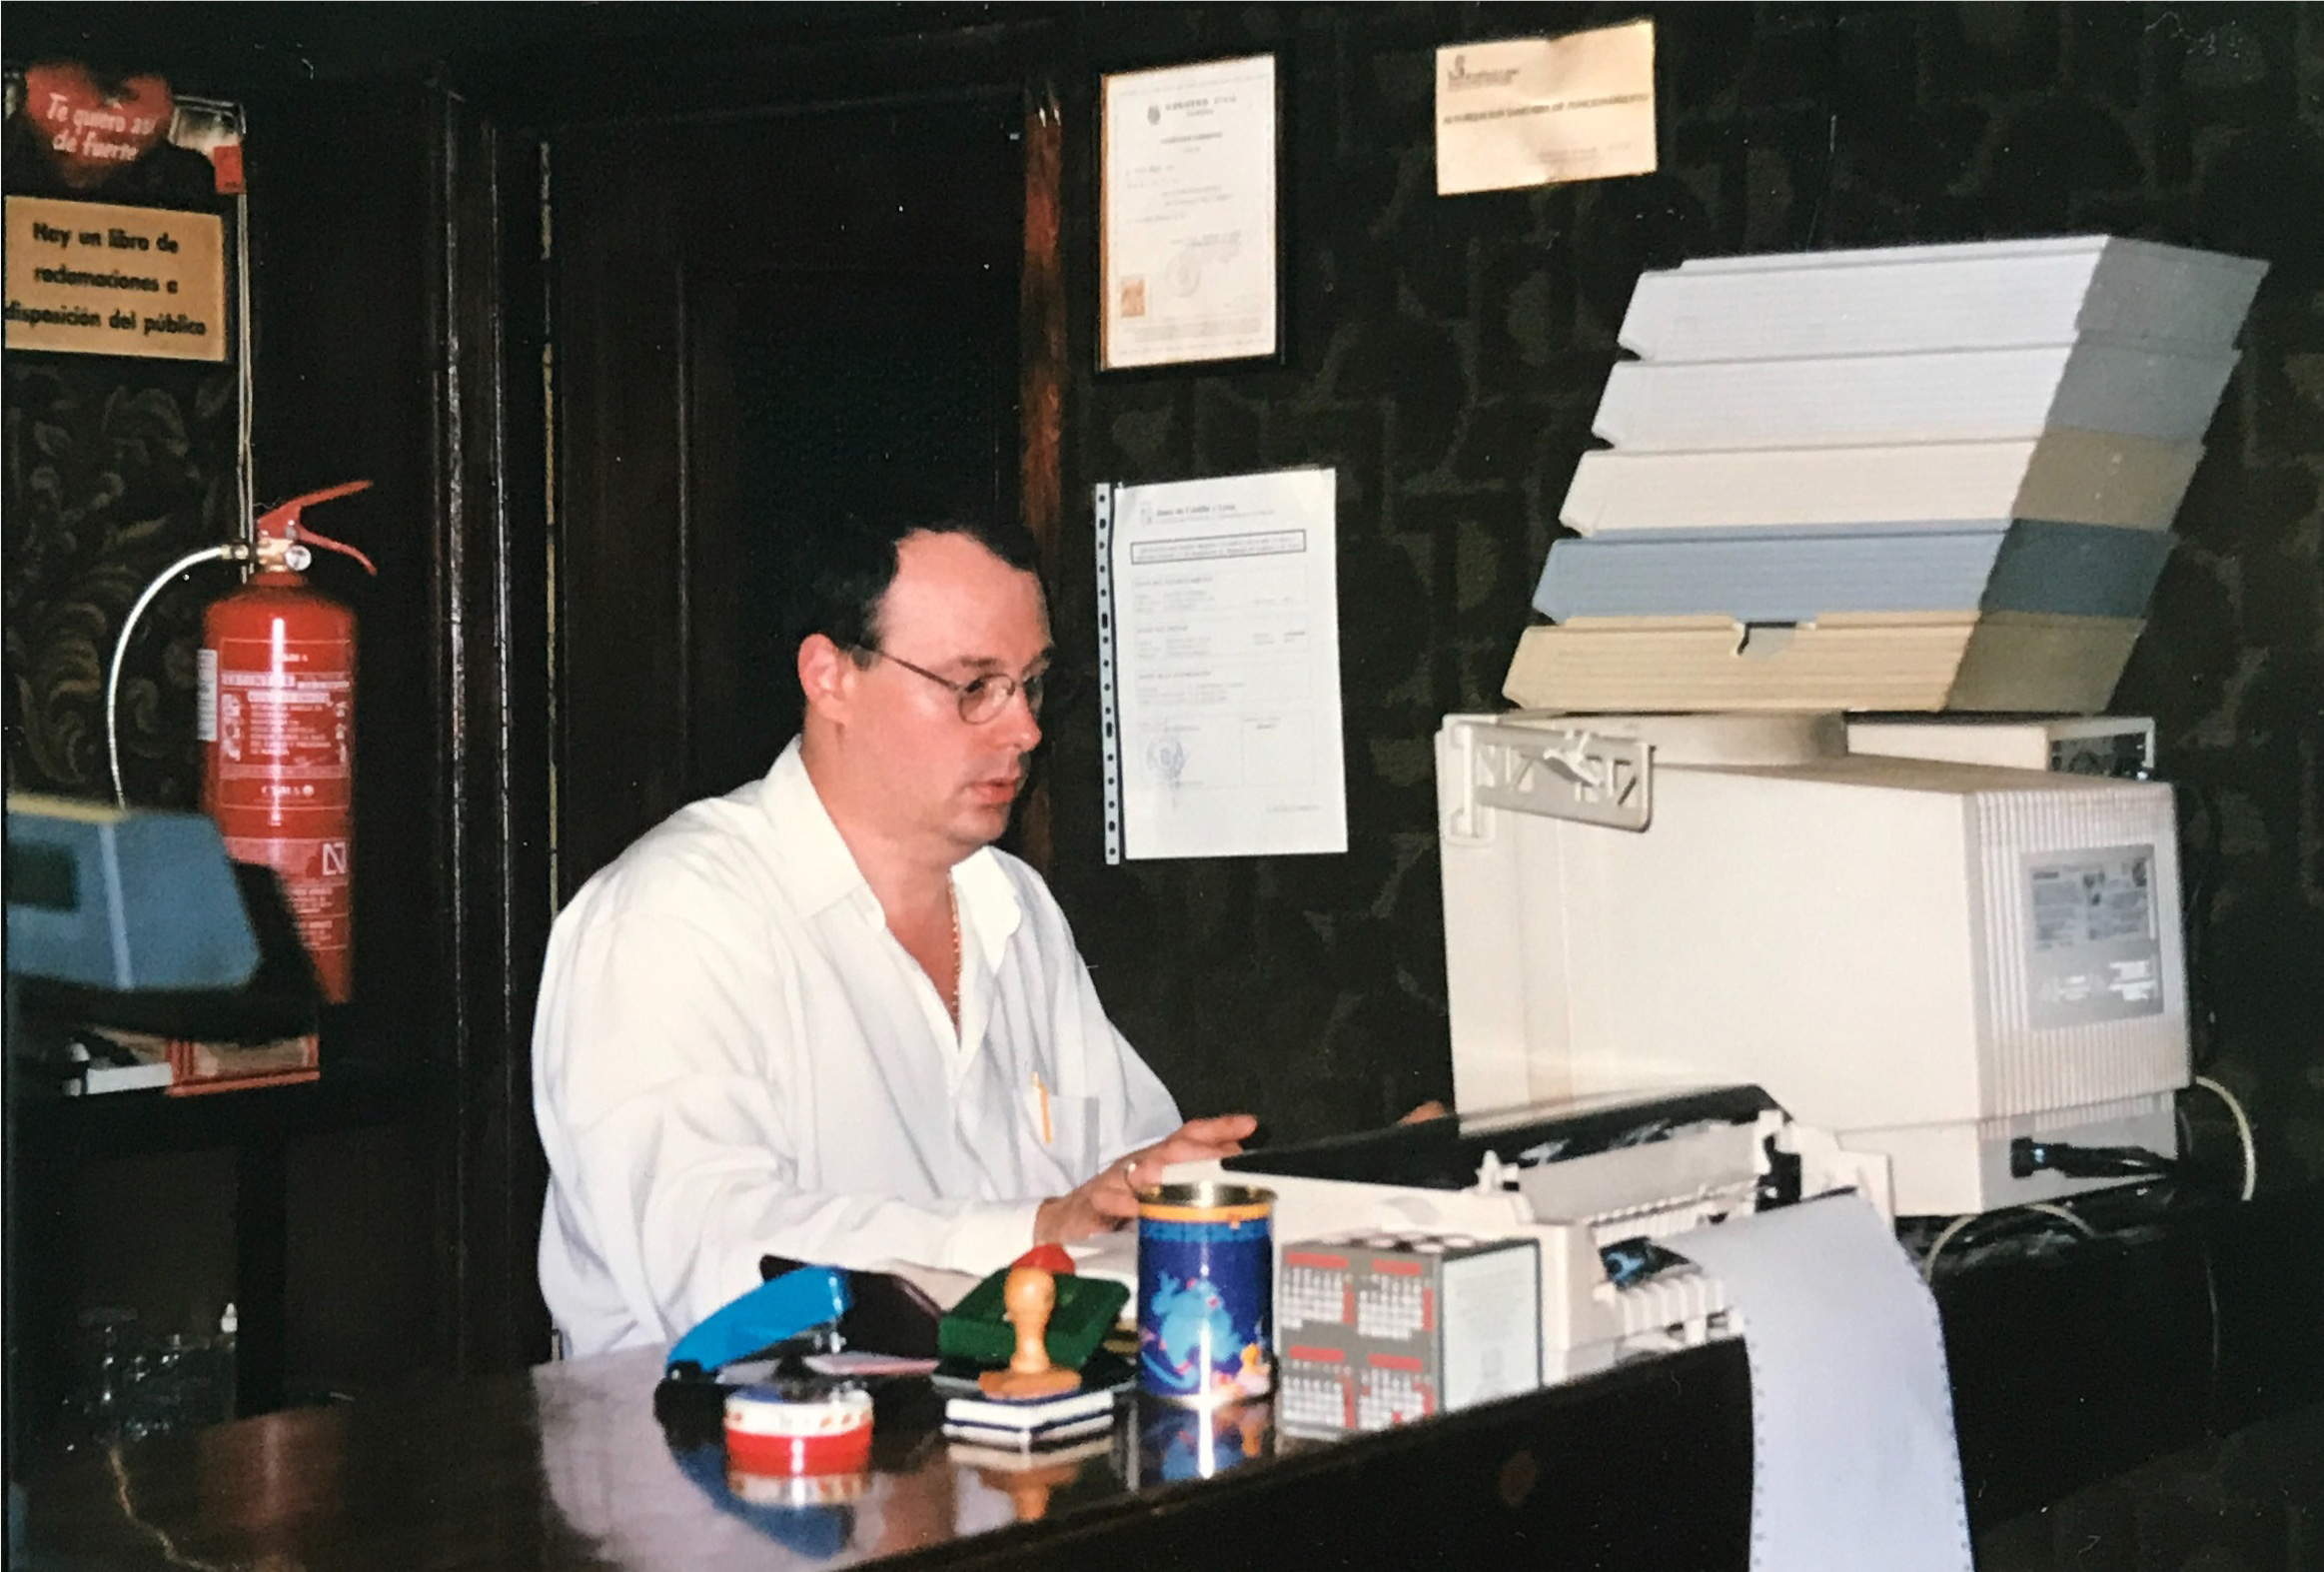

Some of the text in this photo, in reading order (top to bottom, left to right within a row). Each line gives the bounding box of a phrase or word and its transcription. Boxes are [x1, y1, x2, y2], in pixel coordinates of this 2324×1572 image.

[46, 92, 69, 122] Te
[52, 130, 77, 154] de
[33, 222, 179, 254] Hay un libro de
[34, 264, 159, 293] reclamaciones
[109, 308, 137, 330] del
[144, 313, 206, 337] público
